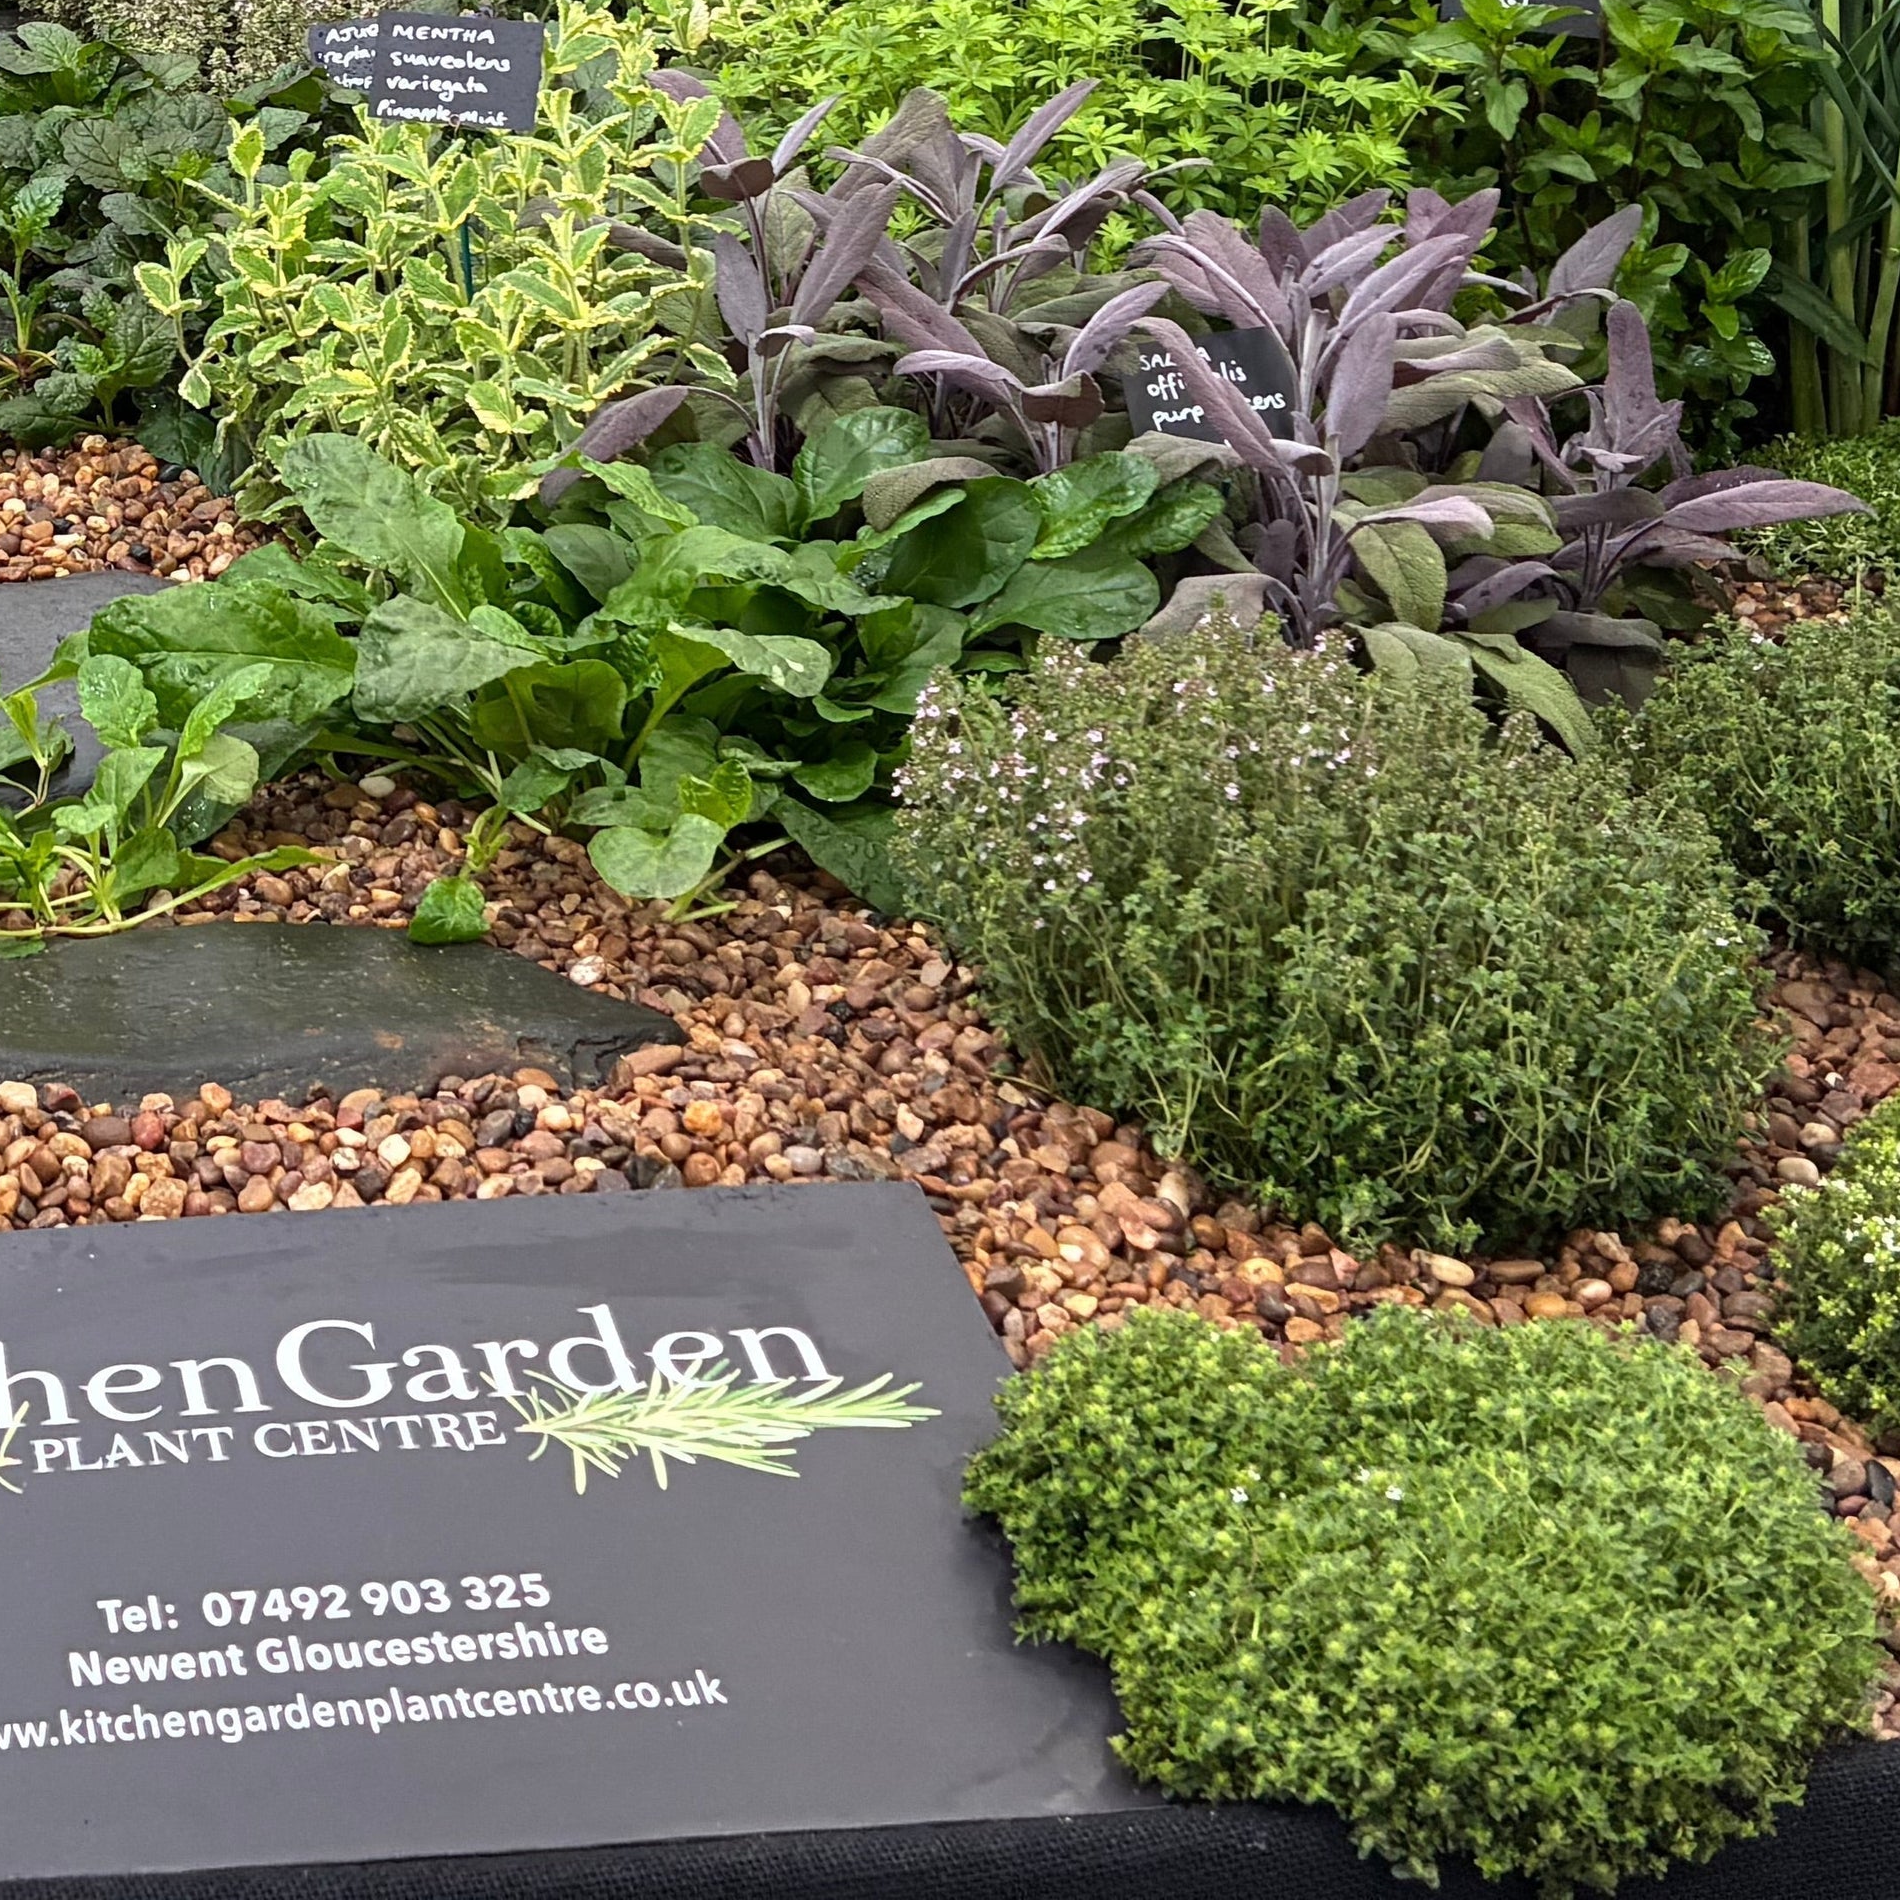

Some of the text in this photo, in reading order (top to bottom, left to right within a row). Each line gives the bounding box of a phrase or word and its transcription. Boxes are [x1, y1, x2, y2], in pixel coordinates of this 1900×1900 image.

[392, 24, 496, 44] MENTHA
[390, 50, 511, 72] suaveolens
[386, 75, 488, 102] variegata
[32, 1410, 507, 1474] PLANT CENTRE
[97, 1572, 551, 1634] Tel: 07492 903 325
[68, 1621, 609, 1688] Newent Gloucestershire
